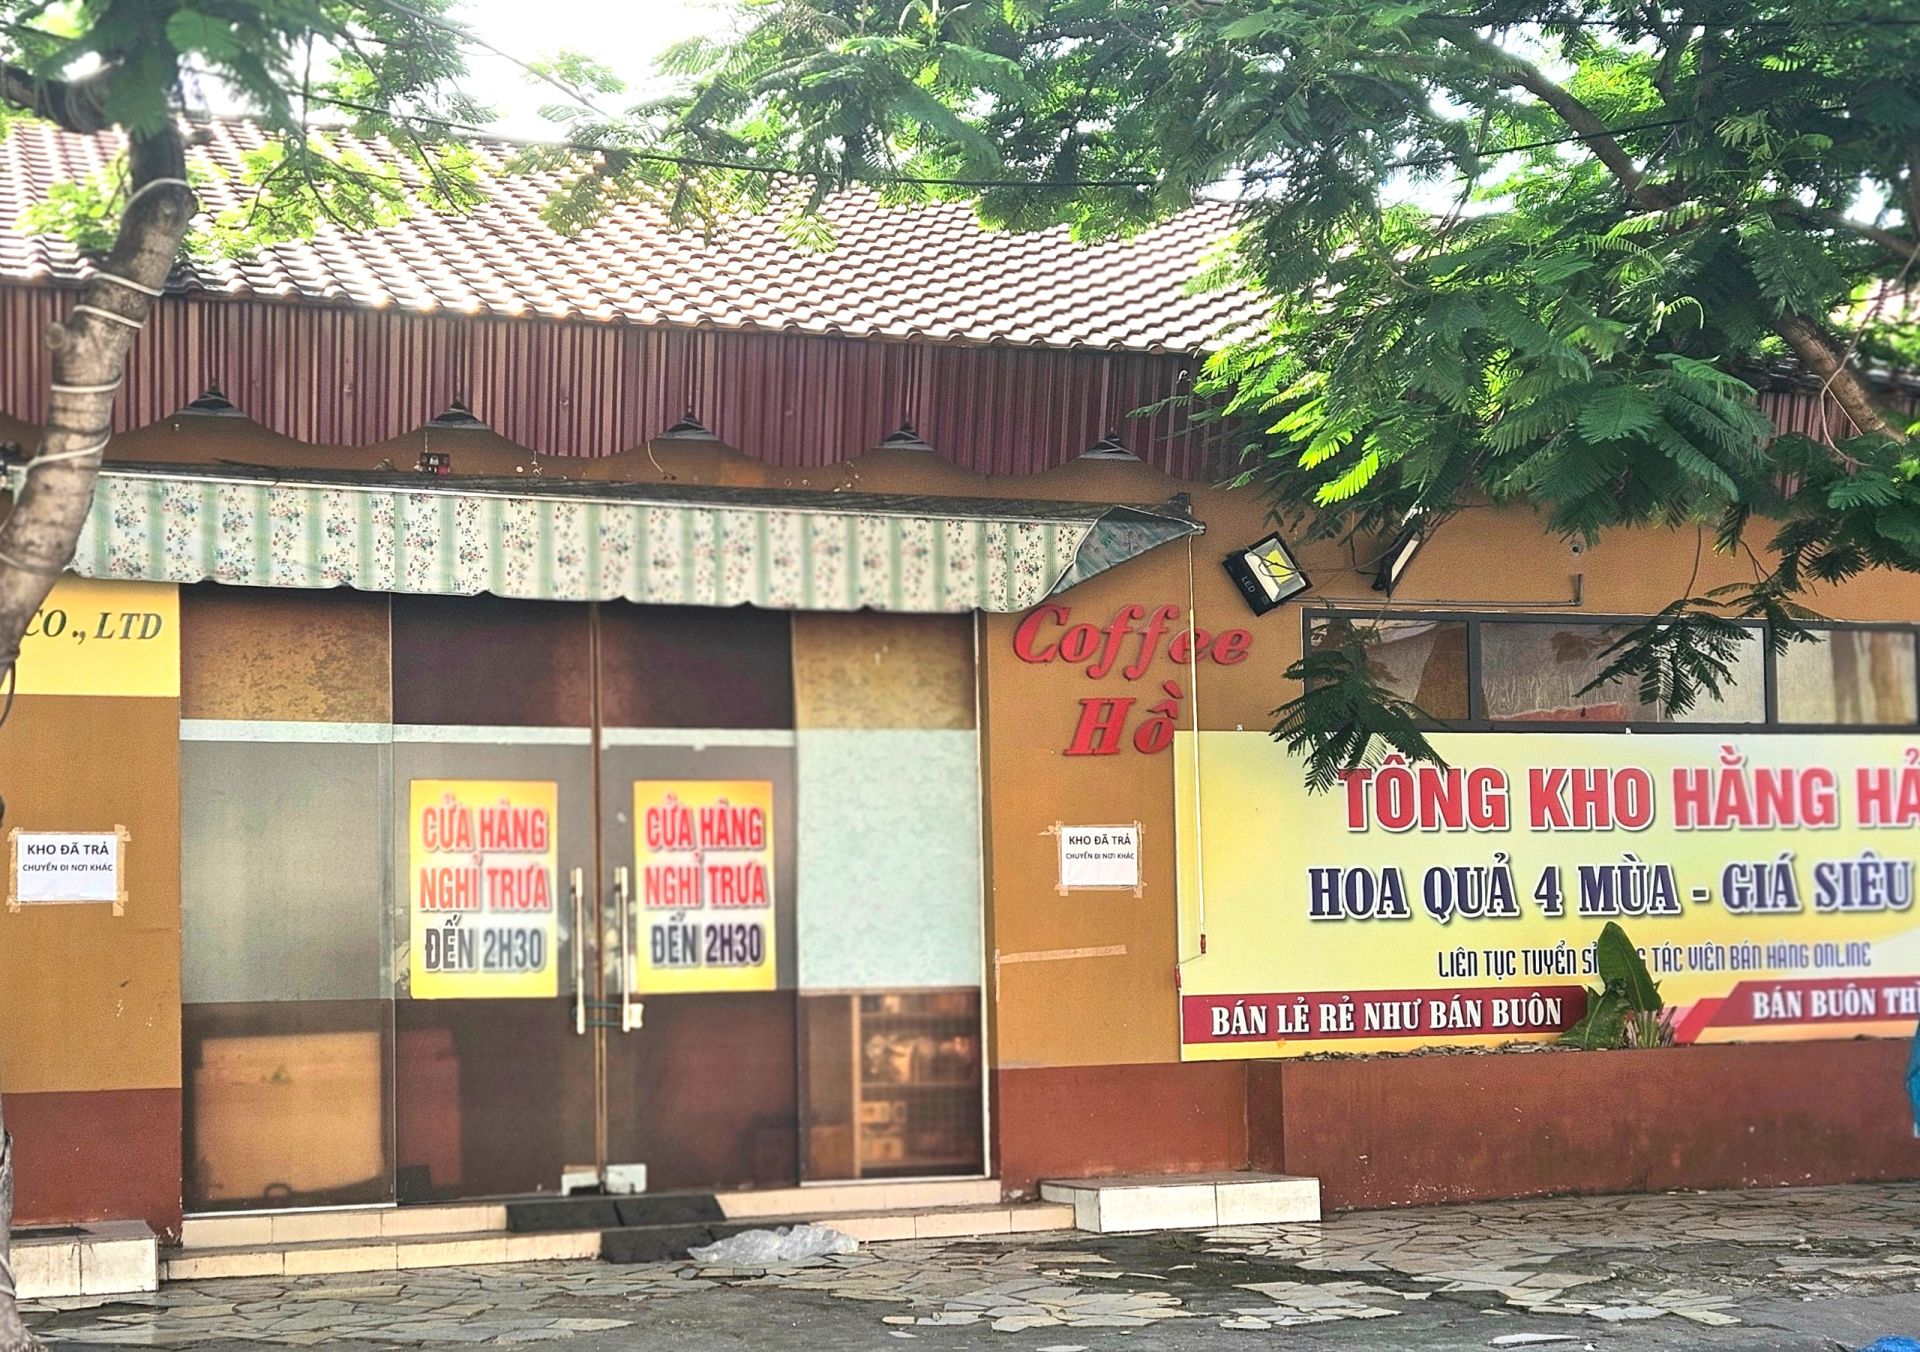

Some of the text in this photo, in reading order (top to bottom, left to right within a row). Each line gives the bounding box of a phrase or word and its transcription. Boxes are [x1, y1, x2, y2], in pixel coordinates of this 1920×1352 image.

[94, 612, 162, 640] LTD
[1013, 603, 1253, 681] Coffee
[1062, 679, 1184, 756] Hồ
[422, 793, 548, 849] CỬA HÀNG
[645, 793, 764, 847] CỬA HÀNG
[1529, 767, 1651, 828] KHO
[27, 841, 109, 856] KHO ĐÃ TRẢ
[1068, 832, 1132, 846] KHO ĐÃ TRẢ
[60, 864, 69, 872] ĐI
[420, 854, 549, 909] NGHỈ TRƯA
[645, 852, 767, 905] NGHỈ TRƯA
[1309, 867, 1408, 916] HOA
[1424, 852, 1517, 920] QUẢ
[1534, 866, 1560, 912] 4
[1578, 854, 1678, 912] MÙA
[1722, 853, 1799, 909] GIÁ
[1814, 851, 1910, 907] SIÊU
[425, 914, 543, 969] ĐẾN 2H30
[651, 912, 762, 964] ĐẾN 2H30
[1483, 949, 1517, 980] TỤC
[1652, 941, 1683, 972] TÁC
[1211, 992, 1562, 1036] BÁN LẺ RẺ NHƯ BÁN BUÔN
[1752, 986, 1802, 1019] BÁN
[1810, 983, 1876, 1017] BUÔN
